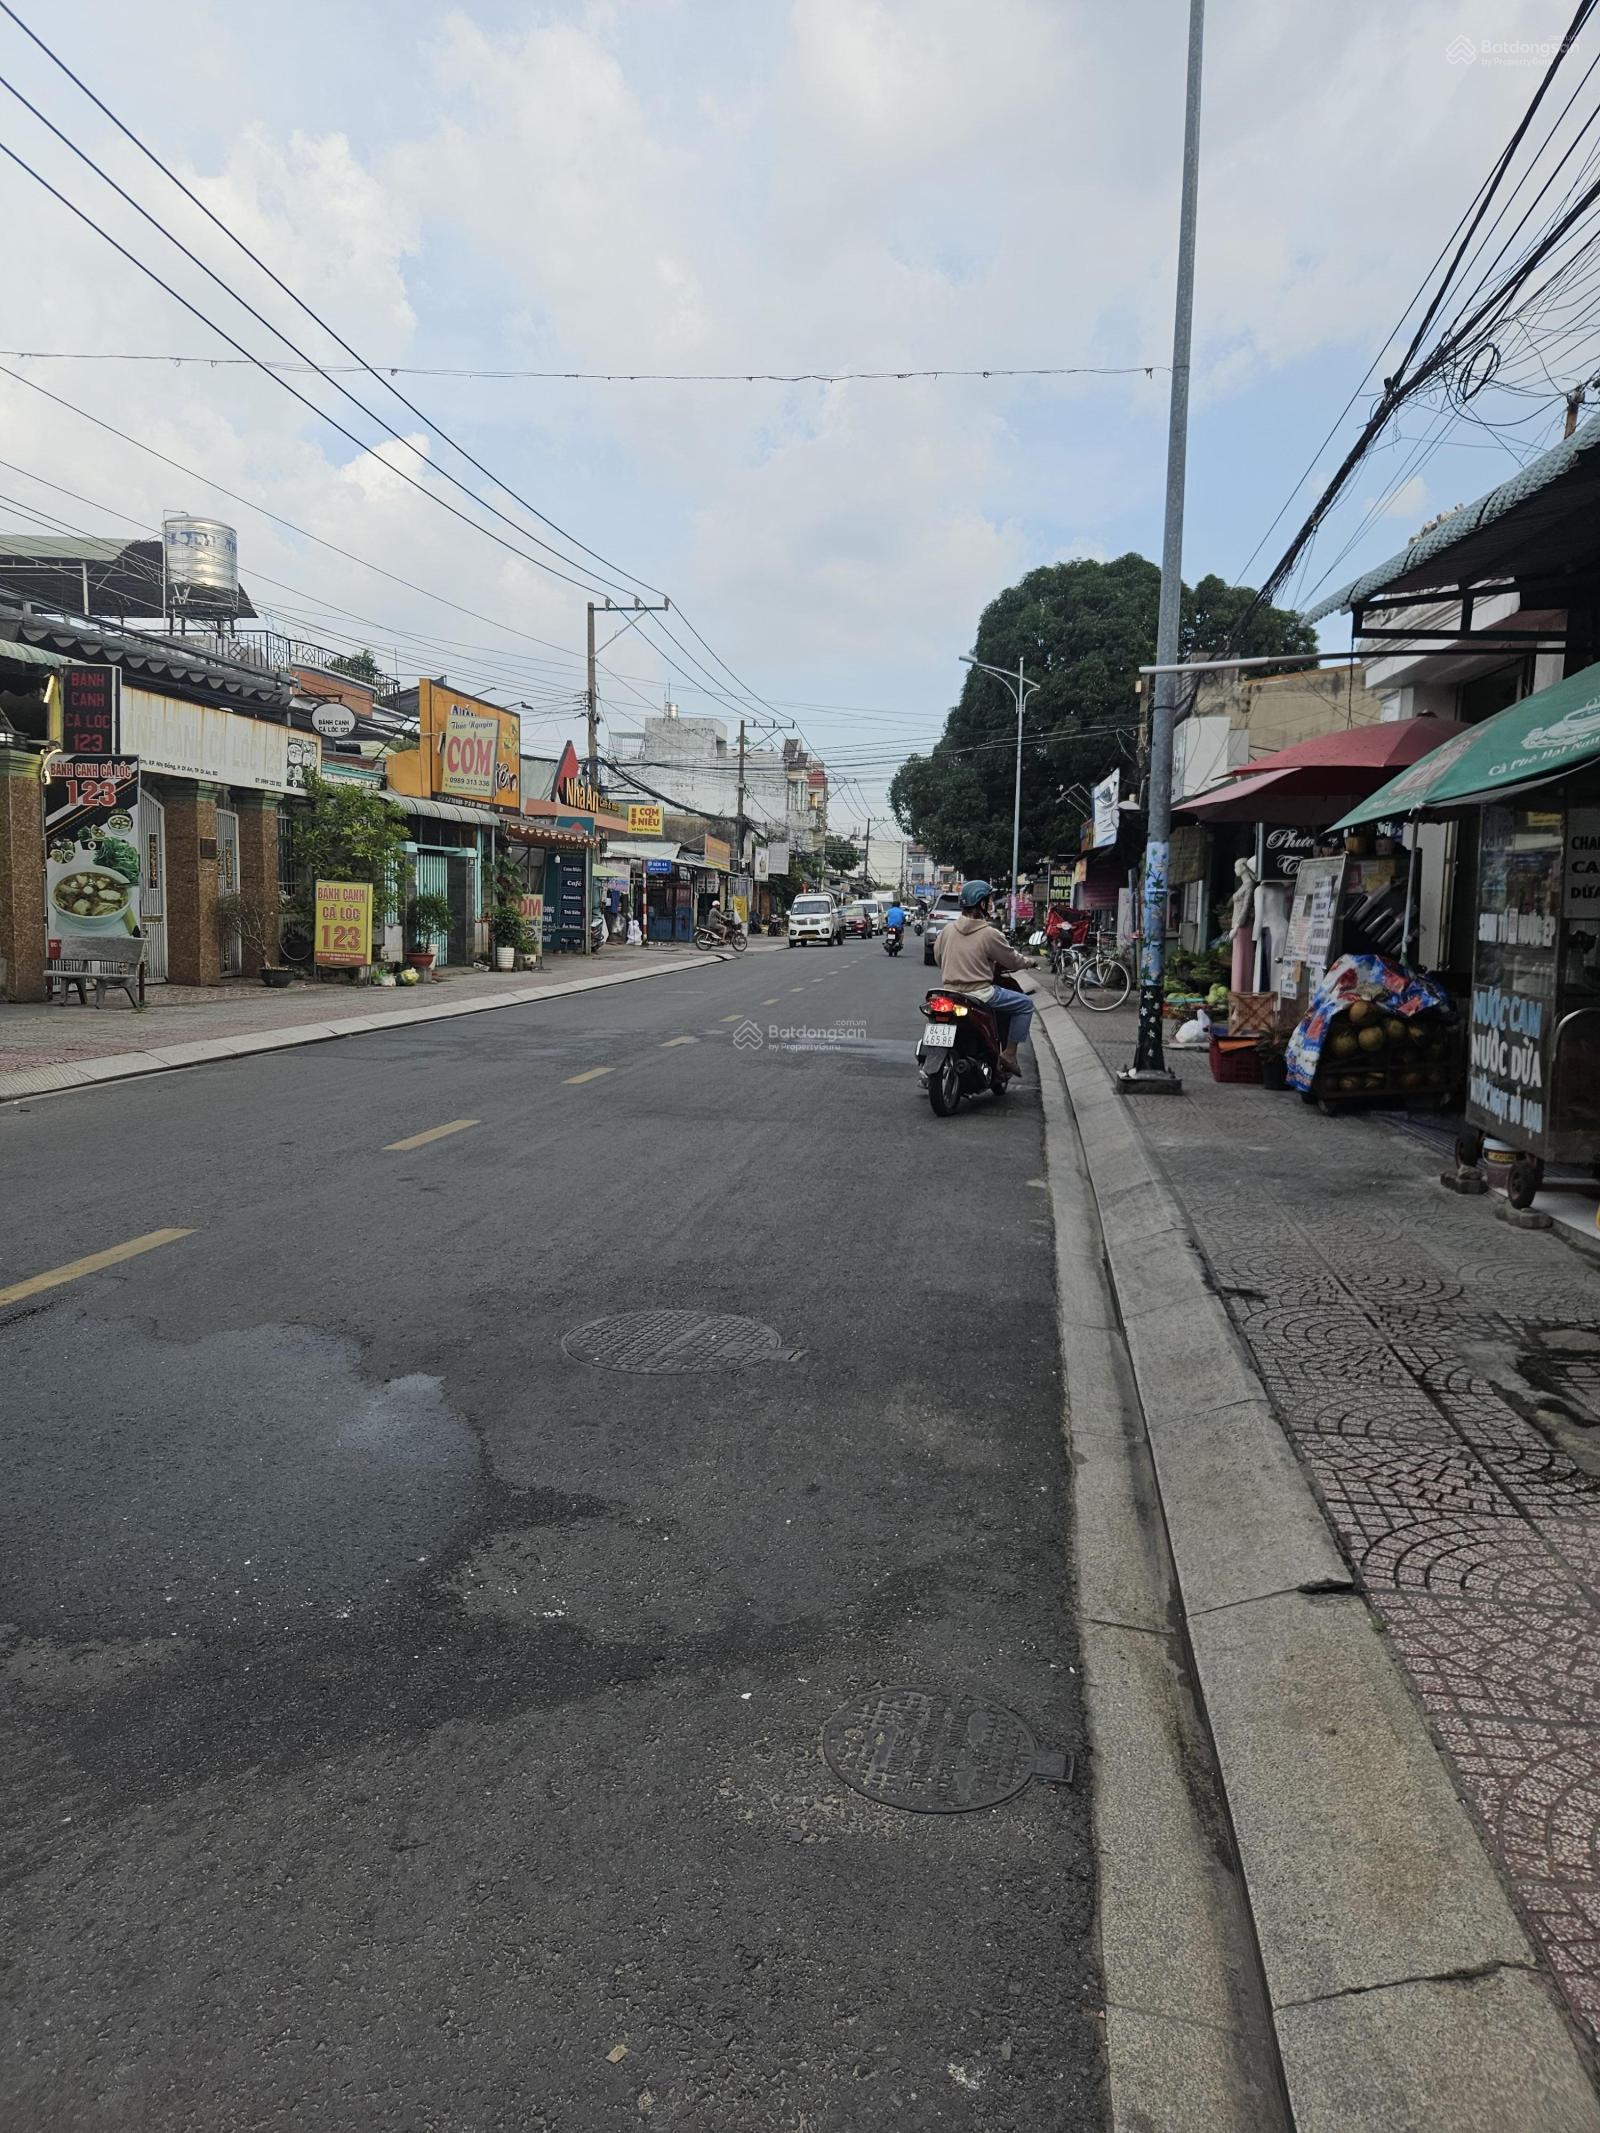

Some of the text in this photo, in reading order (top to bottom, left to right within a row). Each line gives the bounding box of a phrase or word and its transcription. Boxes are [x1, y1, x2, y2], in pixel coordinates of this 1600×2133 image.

[71, 693, 105, 707] CANH
[73, 734, 103, 752] 123
[447, 731, 493, 776] CƠM
[75, 763, 99, 778] CANH
[100, 760, 113, 778] CÁ
[66, 780, 117, 806] 123
[639, 807, 659, 817] CƠM
[1571, 836, 1600, 850] CHA
[317, 884, 365, 902] BÁNH CANH
[1050, 889, 1071, 900] ROLE
[322, 925, 361, 951] 123
[1471, 1028, 1542, 1088] NƯỚC DỪA
